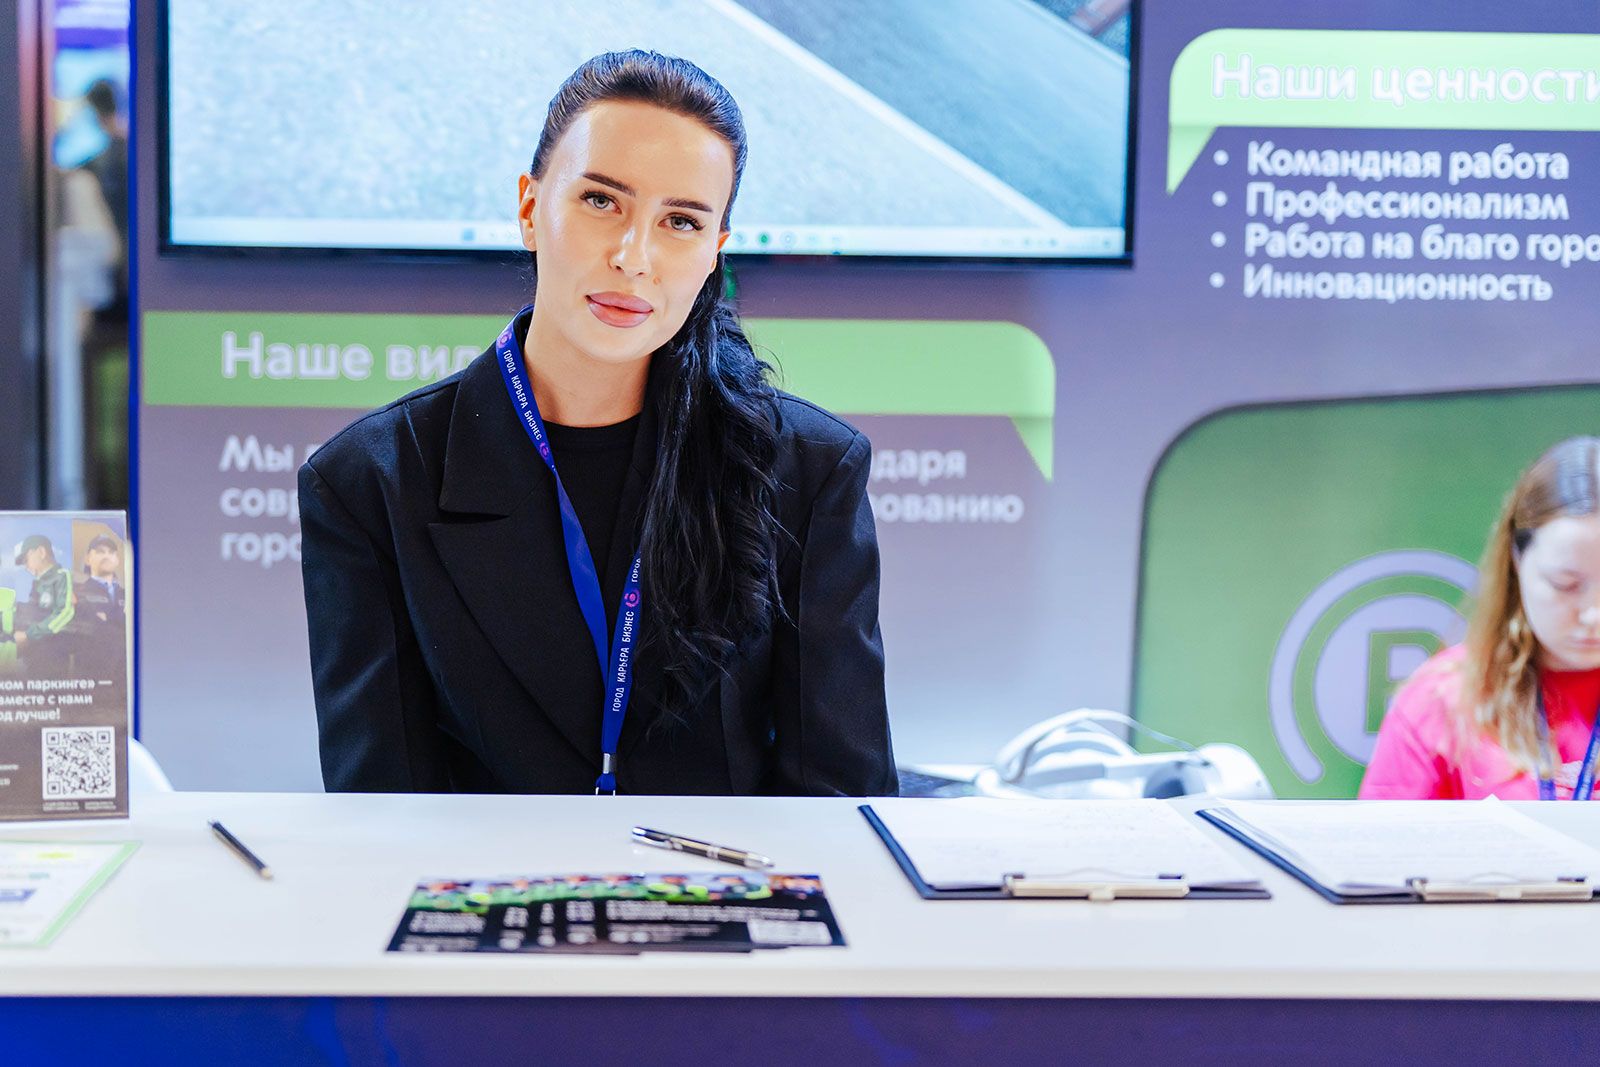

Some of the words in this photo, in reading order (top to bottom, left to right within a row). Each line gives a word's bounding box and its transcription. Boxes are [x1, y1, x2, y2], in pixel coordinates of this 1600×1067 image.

[1211, 52, 1357, 101] Наши
[1247, 140, 1442, 182] Командная
[1448, 142, 1570, 185] работа
[1246, 181, 1571, 224] Профессионализм
[1244, 221, 1366, 260] Работа
[1372, 230, 1414, 259] на
[1420, 223, 1520, 261] благо
[1526, 233, 1600, 269] горо
[1243, 263, 1554, 303] Инновационность
[221, 331, 374, 380] Наше
[502, 349, 516, 374] ГОРОД
[511, 374, 529, 409] КАРЬЕРА
[524, 410, 543, 441] БИЗНЕС
[219, 434, 295, 473] Мы
[621, 611, 635, 643] БИЗНЕС
[616, 647, 630, 683] КАРЬЕРА
[15, 707, 61, 724] лучше!
[47, 694, 57, 705] с
[58, 694, 93, 705] нами
[612, 687, 625, 712] ГОРОД
